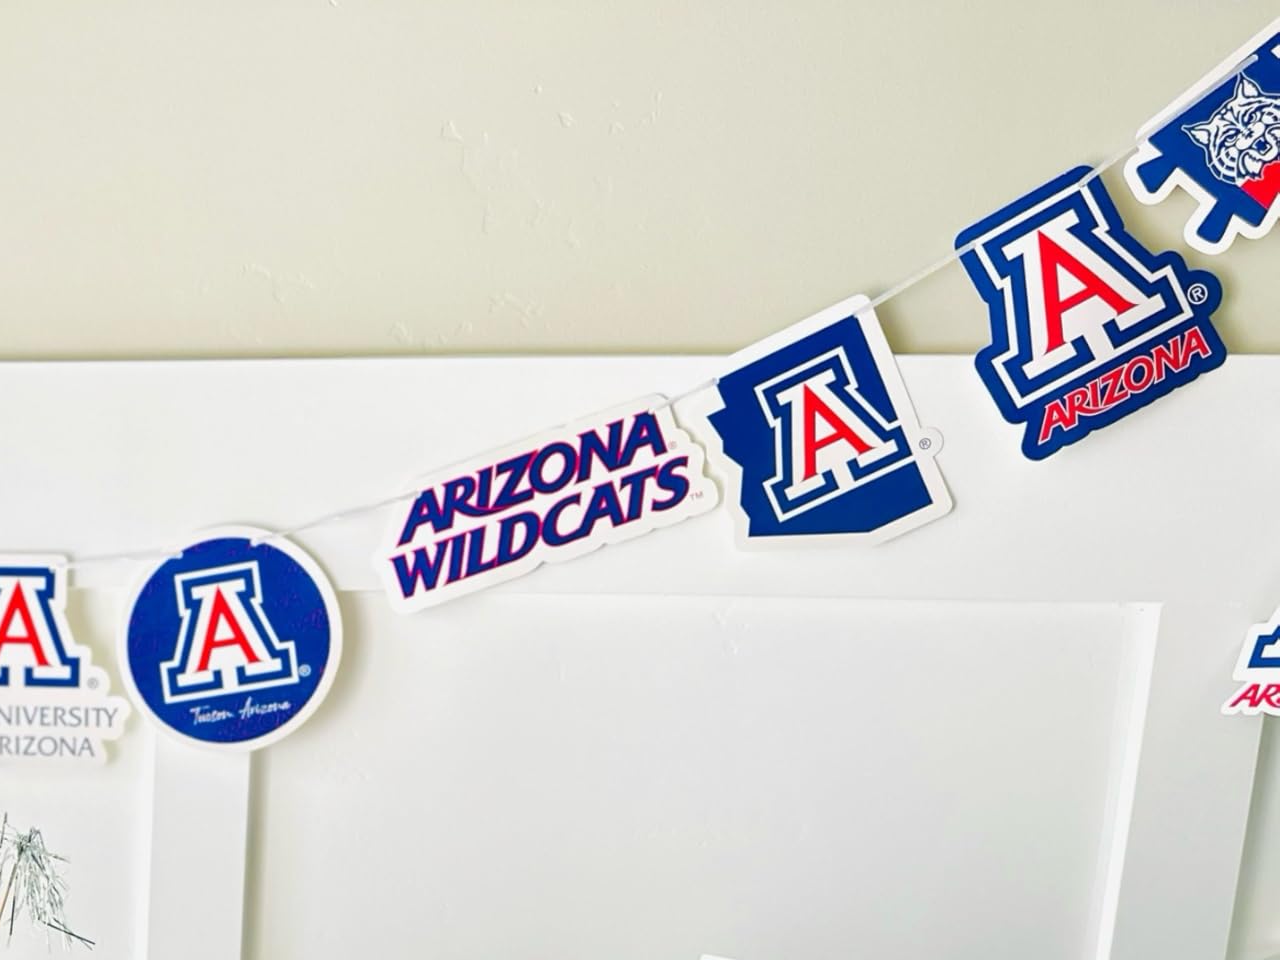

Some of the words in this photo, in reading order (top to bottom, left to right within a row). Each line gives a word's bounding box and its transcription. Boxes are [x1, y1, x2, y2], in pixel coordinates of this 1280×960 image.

[975, 184, 1194, 409] A
[753, 346, 919, 523] A
[1037, 325, 1212, 446] ARIZONA
[390, 456, 690, 600] WILDCATS
[396, 410, 668, 547] ARIZONA
[160, 560, 300, 704] A
